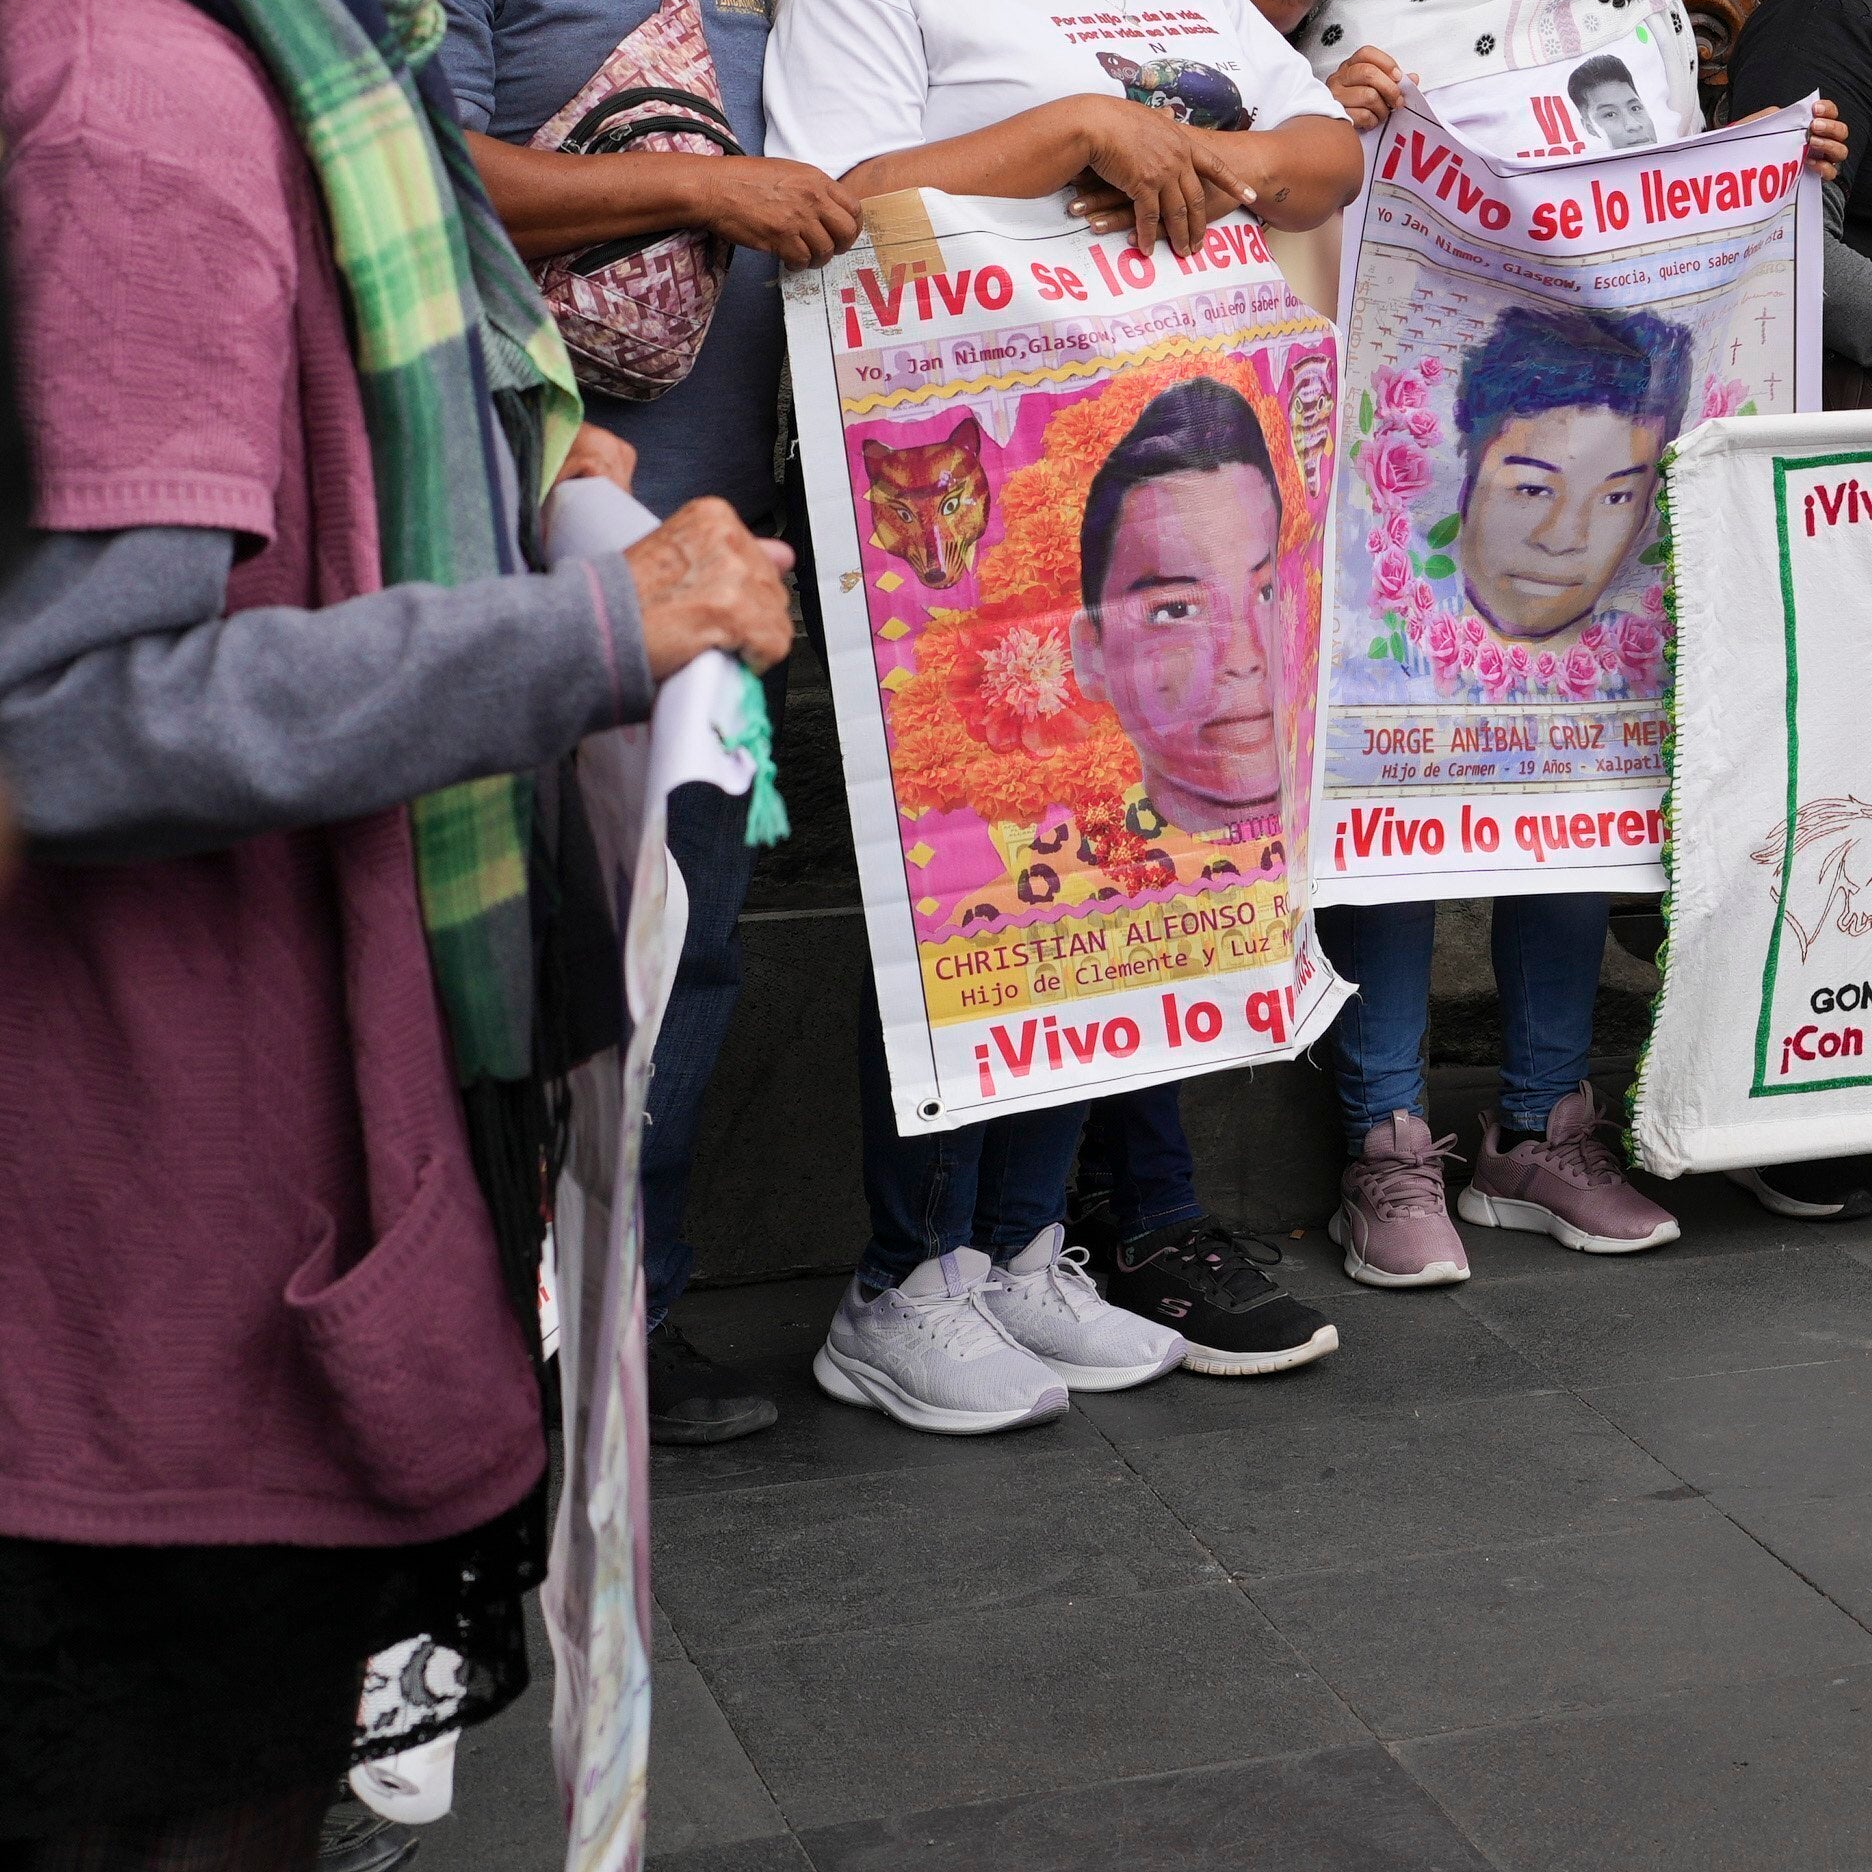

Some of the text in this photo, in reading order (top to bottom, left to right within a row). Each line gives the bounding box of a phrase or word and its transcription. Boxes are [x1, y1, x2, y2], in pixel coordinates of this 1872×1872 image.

[1050, 14, 1076, 27] Por
[1078, 13, 1097, 24] un
[1095, 13, 1121, 25] hijo
[1159, 10, 1175, 20] la
[1065, 31, 1077, 44] y
[1079, 30, 1100, 42] por
[1100, 28, 1115, 39] la
[1115, 27, 1145, 38] vida
[1163, 25, 1182, 35] la
[1381, 129, 1512, 231] ¡Vivo
[1528, 197, 1584, 241] se
[1591, 180, 1630, 233] lo
[1400, 212, 1430, 237] Jan
[1435, 235, 1491, 267] Nimmo,
[1502, 260, 1581, 293] Glasgow,
[1594, 271, 1651, 290] Escocia,
[1659, 258, 1701, 281] quiero
[1708, 250, 1740, 270] saber
[840, 242, 1157, 349] ¡Vivo se lo
[855, 296, 1286, 384] Yo, Jan Escocia, quiero saber
[1362, 727, 1434, 756] JORGE
[1451, 719, 1536, 753] ANÍBAL
[1549, 723, 1605, 750] CRUZ
[1381, 764, 1417, 782] Hijo
[1424, 762, 1440, 778] de
[1448, 760, 1496, 777] Carmen
[1518, 760, 1535, 775] 19
[1543, 759, 1572, 774] Años
[1334, 807, 1444, 872] ¡Vivo
[1461, 805, 1499, 854] lo
[935, 901, 1256, 982] CHRISTIAN ALFONSO
[961, 934, 1270, 1008] Hijo de Clemente y Luz
[975, 992, 1223, 1098] ¡Vivo lo
[1779, 1024, 1863, 1074] ¡Con
